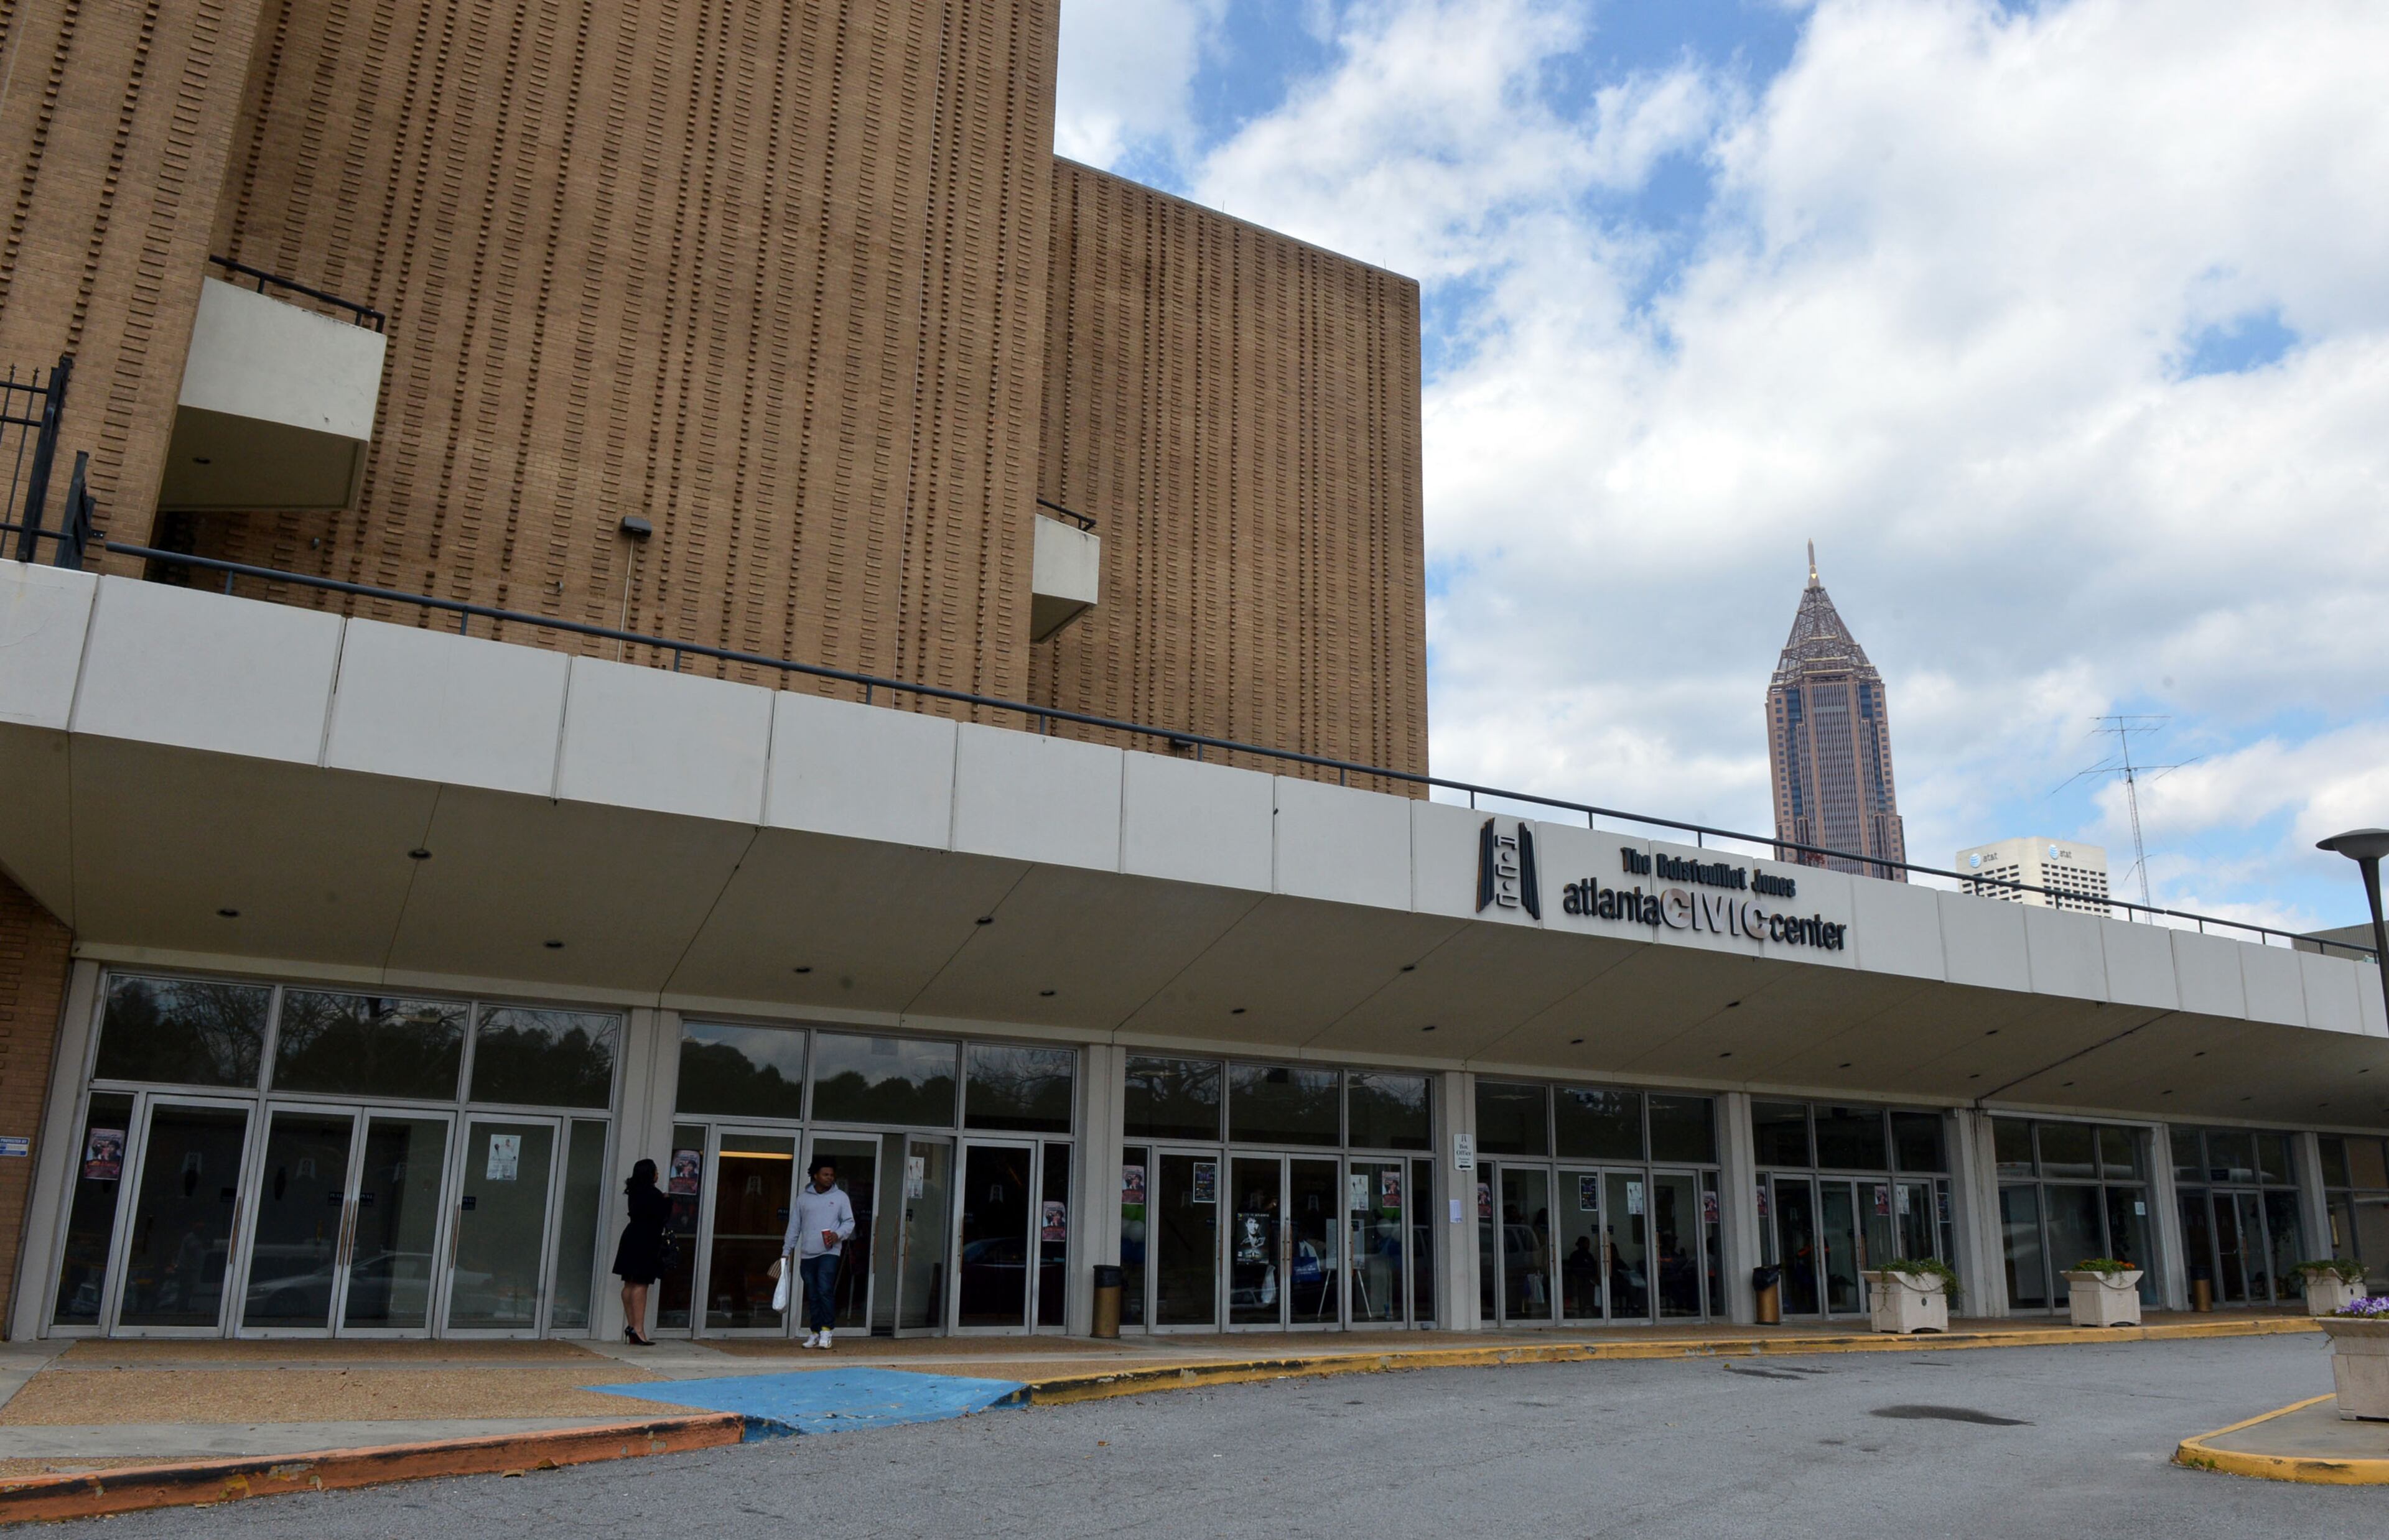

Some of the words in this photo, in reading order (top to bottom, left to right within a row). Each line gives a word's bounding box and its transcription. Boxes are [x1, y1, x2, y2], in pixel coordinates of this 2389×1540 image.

[1621, 847, 1651, 874] The
[1656, 853, 1747, 889] Boisfeuillet
[1751, 869, 1796, 898] Jones
